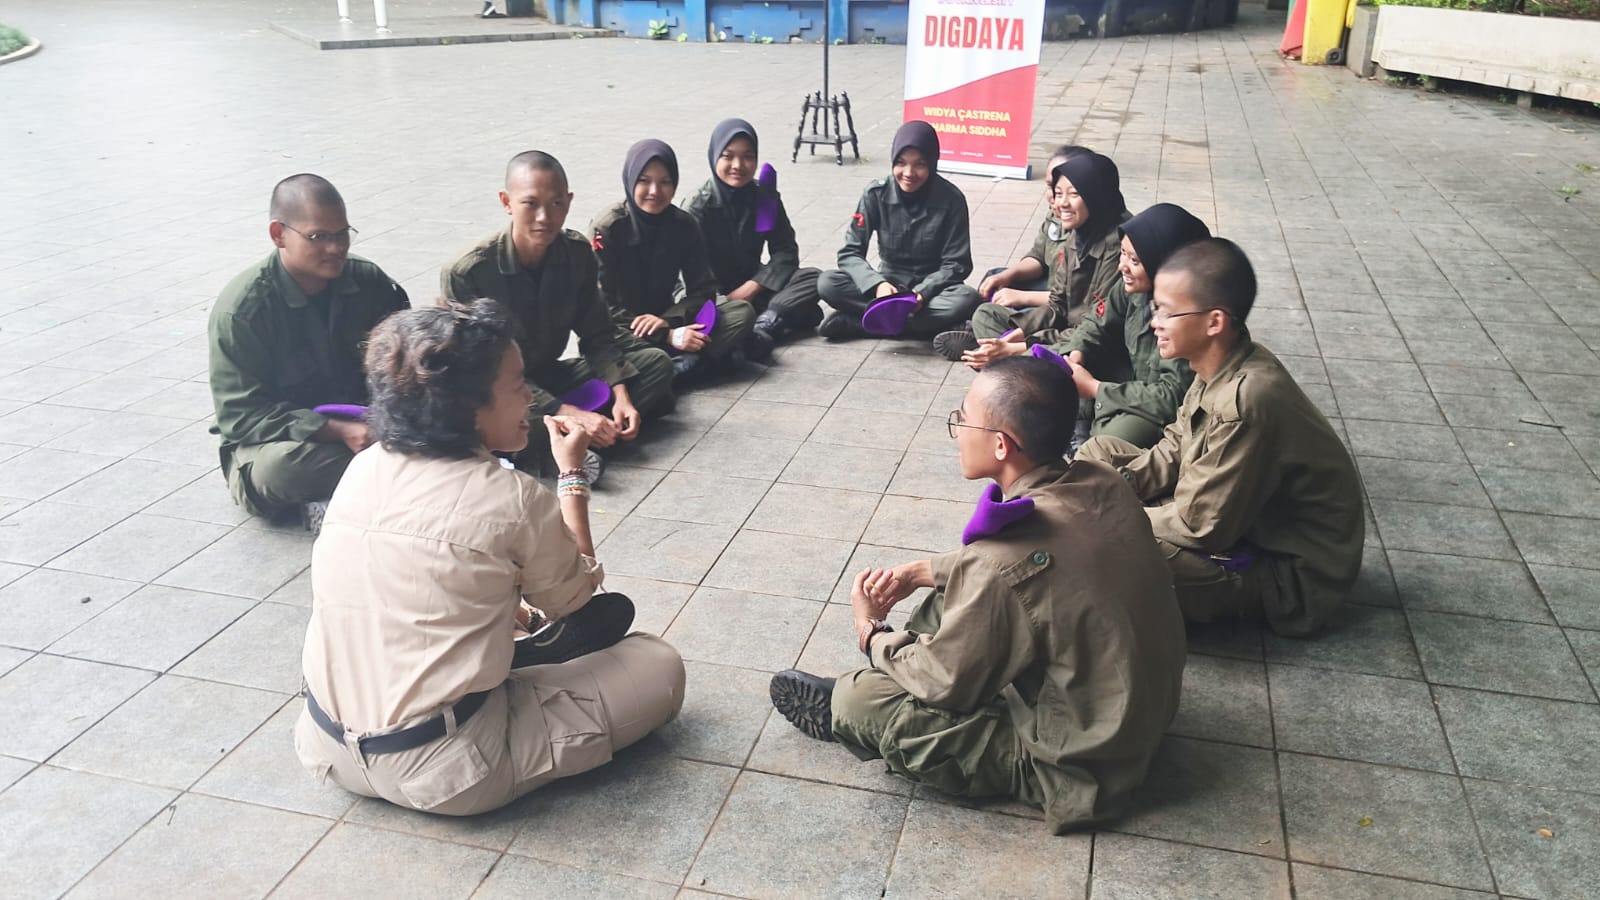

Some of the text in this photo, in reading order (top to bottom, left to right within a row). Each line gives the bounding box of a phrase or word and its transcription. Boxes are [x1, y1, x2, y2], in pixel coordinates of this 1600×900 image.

[925, 15, 1024, 51] DIGDAYA
[923, 106, 956, 118] WIDYA
[931, 122, 1006, 137] HARMA SIDDHA
